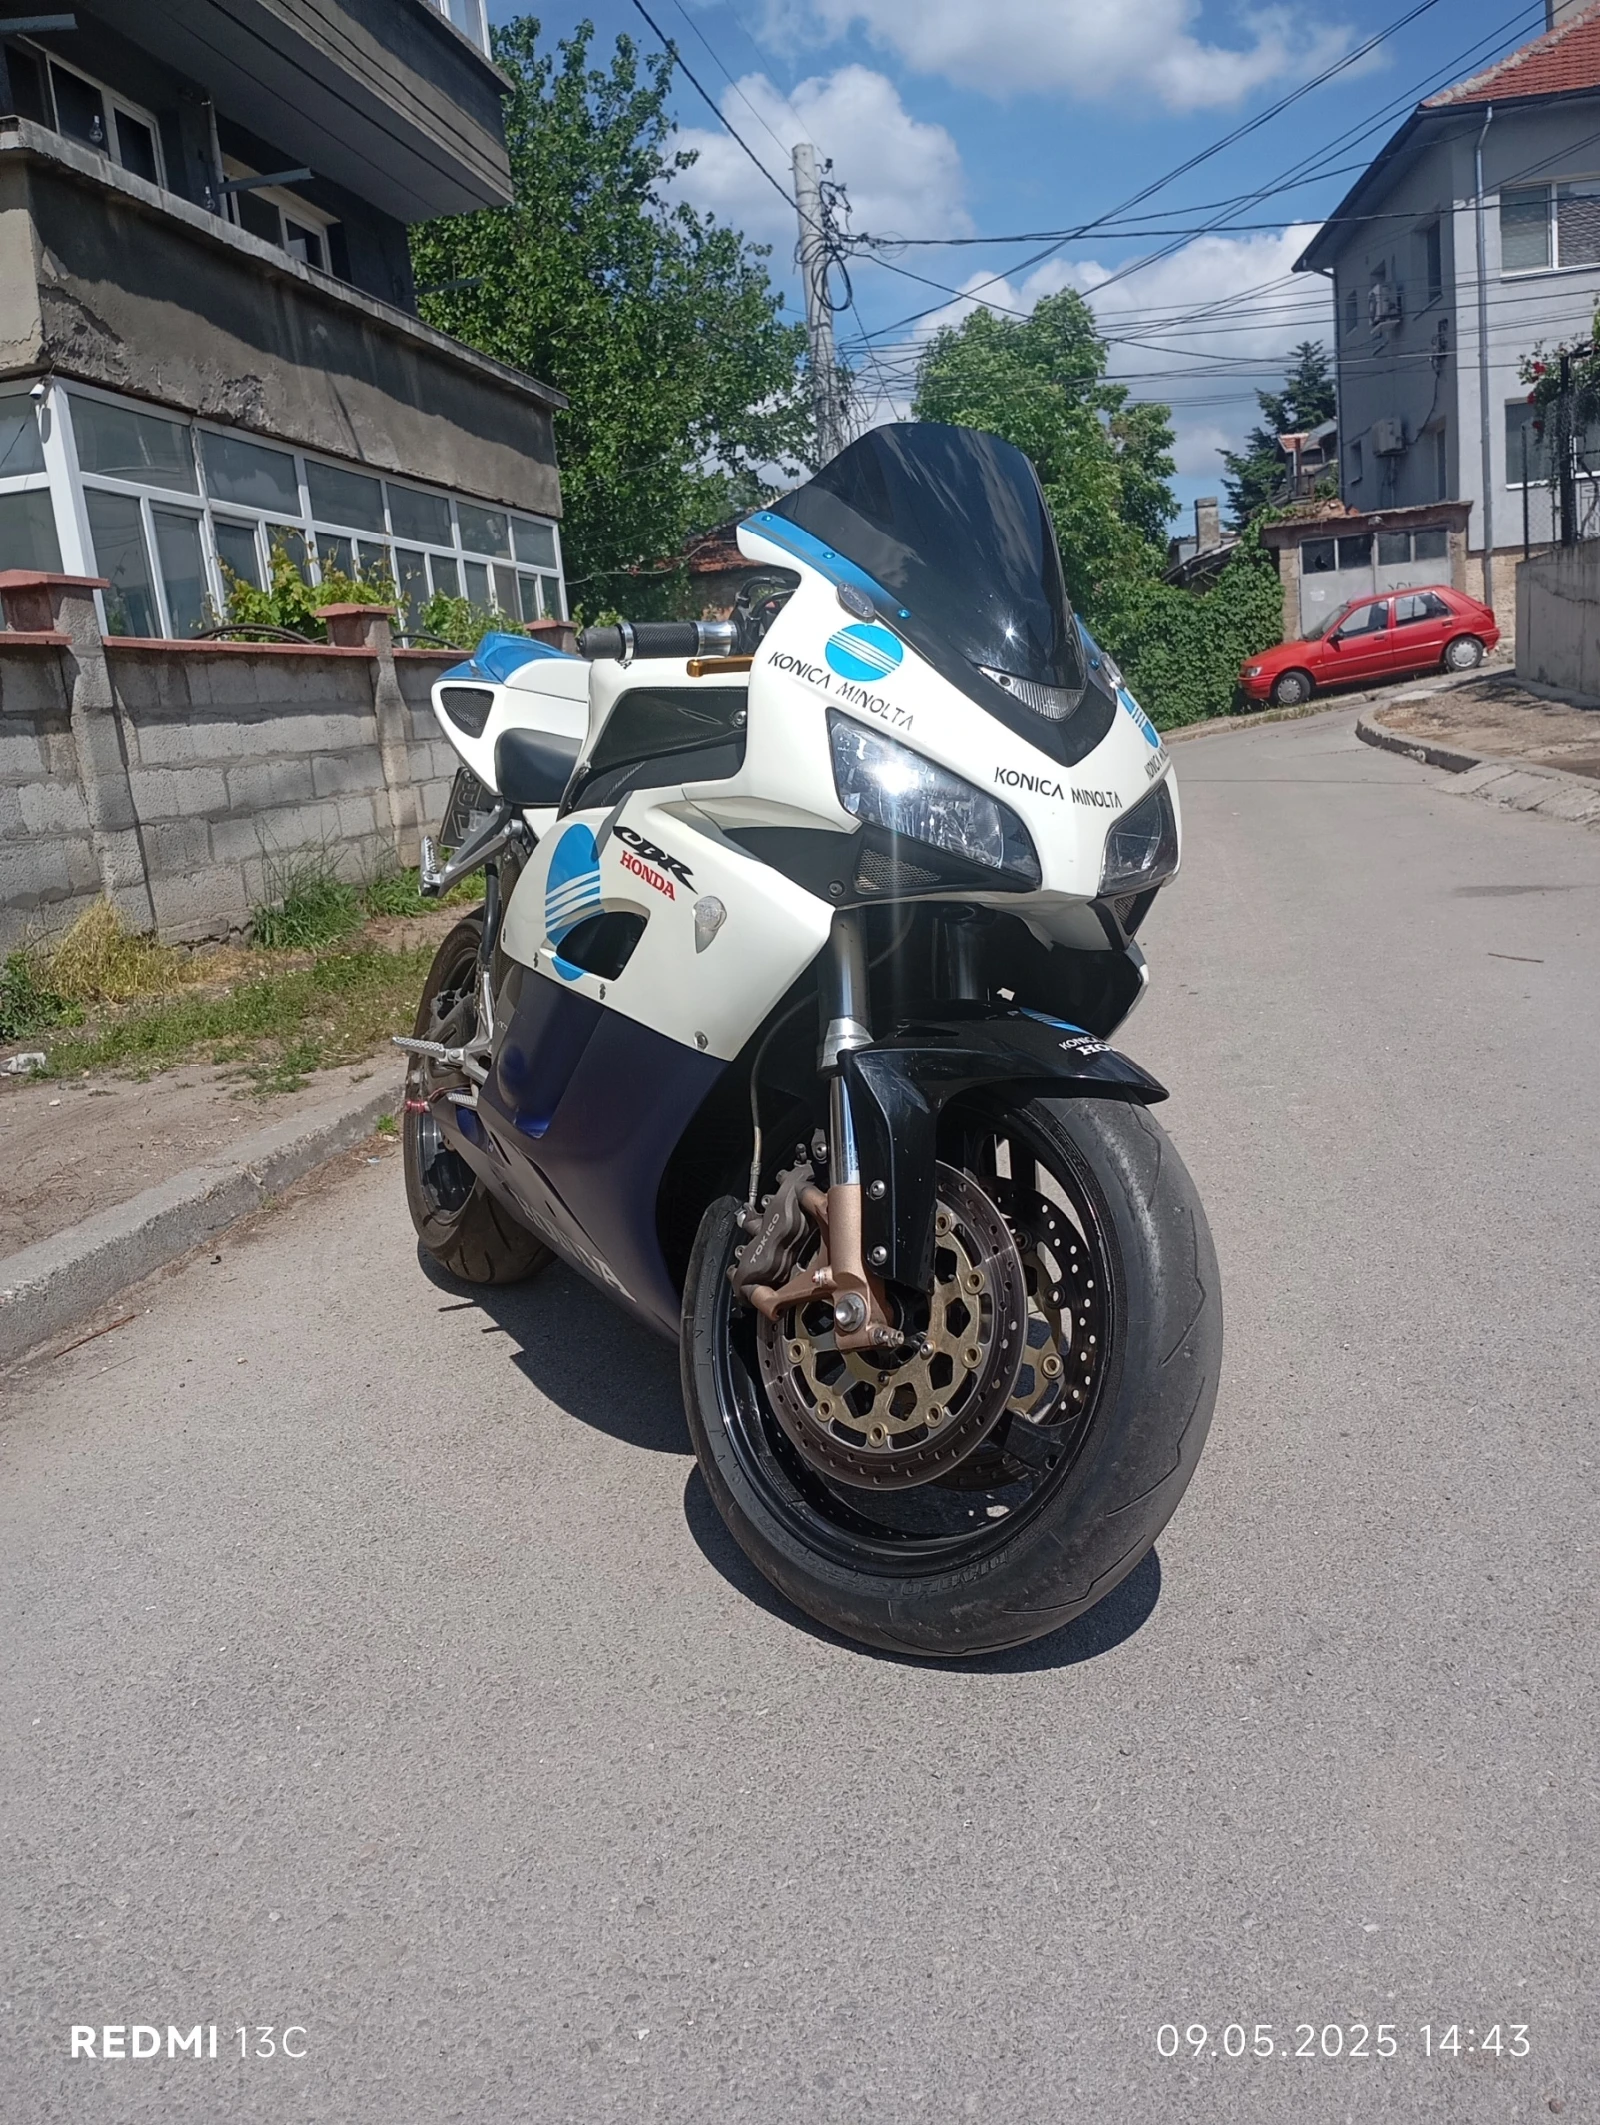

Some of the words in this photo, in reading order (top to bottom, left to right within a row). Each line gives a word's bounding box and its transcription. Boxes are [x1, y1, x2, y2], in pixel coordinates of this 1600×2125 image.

[767, 651, 831, 689] KONICA
[835, 681, 914, 731] MINOLTA
[994, 766, 1064, 801] KONICA
[1070, 787, 1122, 808] MINOLTA
[612, 825, 699, 895] CBR
[619, 849, 675, 901] HONDA
[749, 1213, 780, 1264] TOKICO
